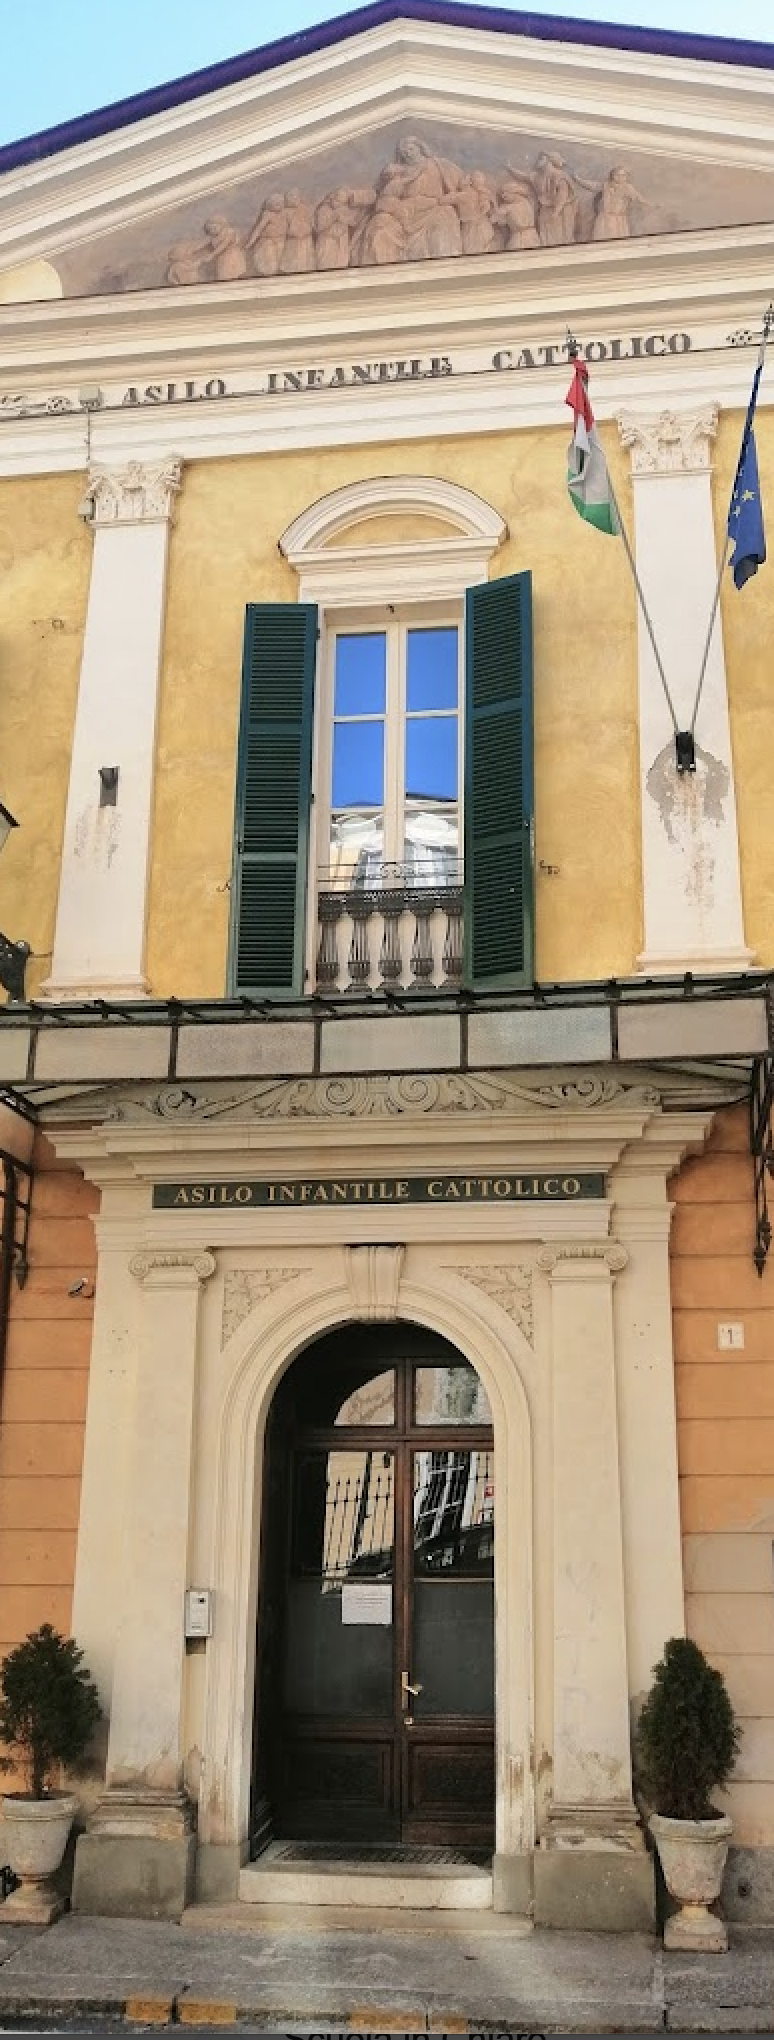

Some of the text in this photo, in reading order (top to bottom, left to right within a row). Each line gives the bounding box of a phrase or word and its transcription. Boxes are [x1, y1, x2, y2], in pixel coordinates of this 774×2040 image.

[122, 333, 691, 405] ASILO INFANTILE CATTOLICO
[174, 1178, 581, 1203] ASILO INFANTILE CATTOLICO
